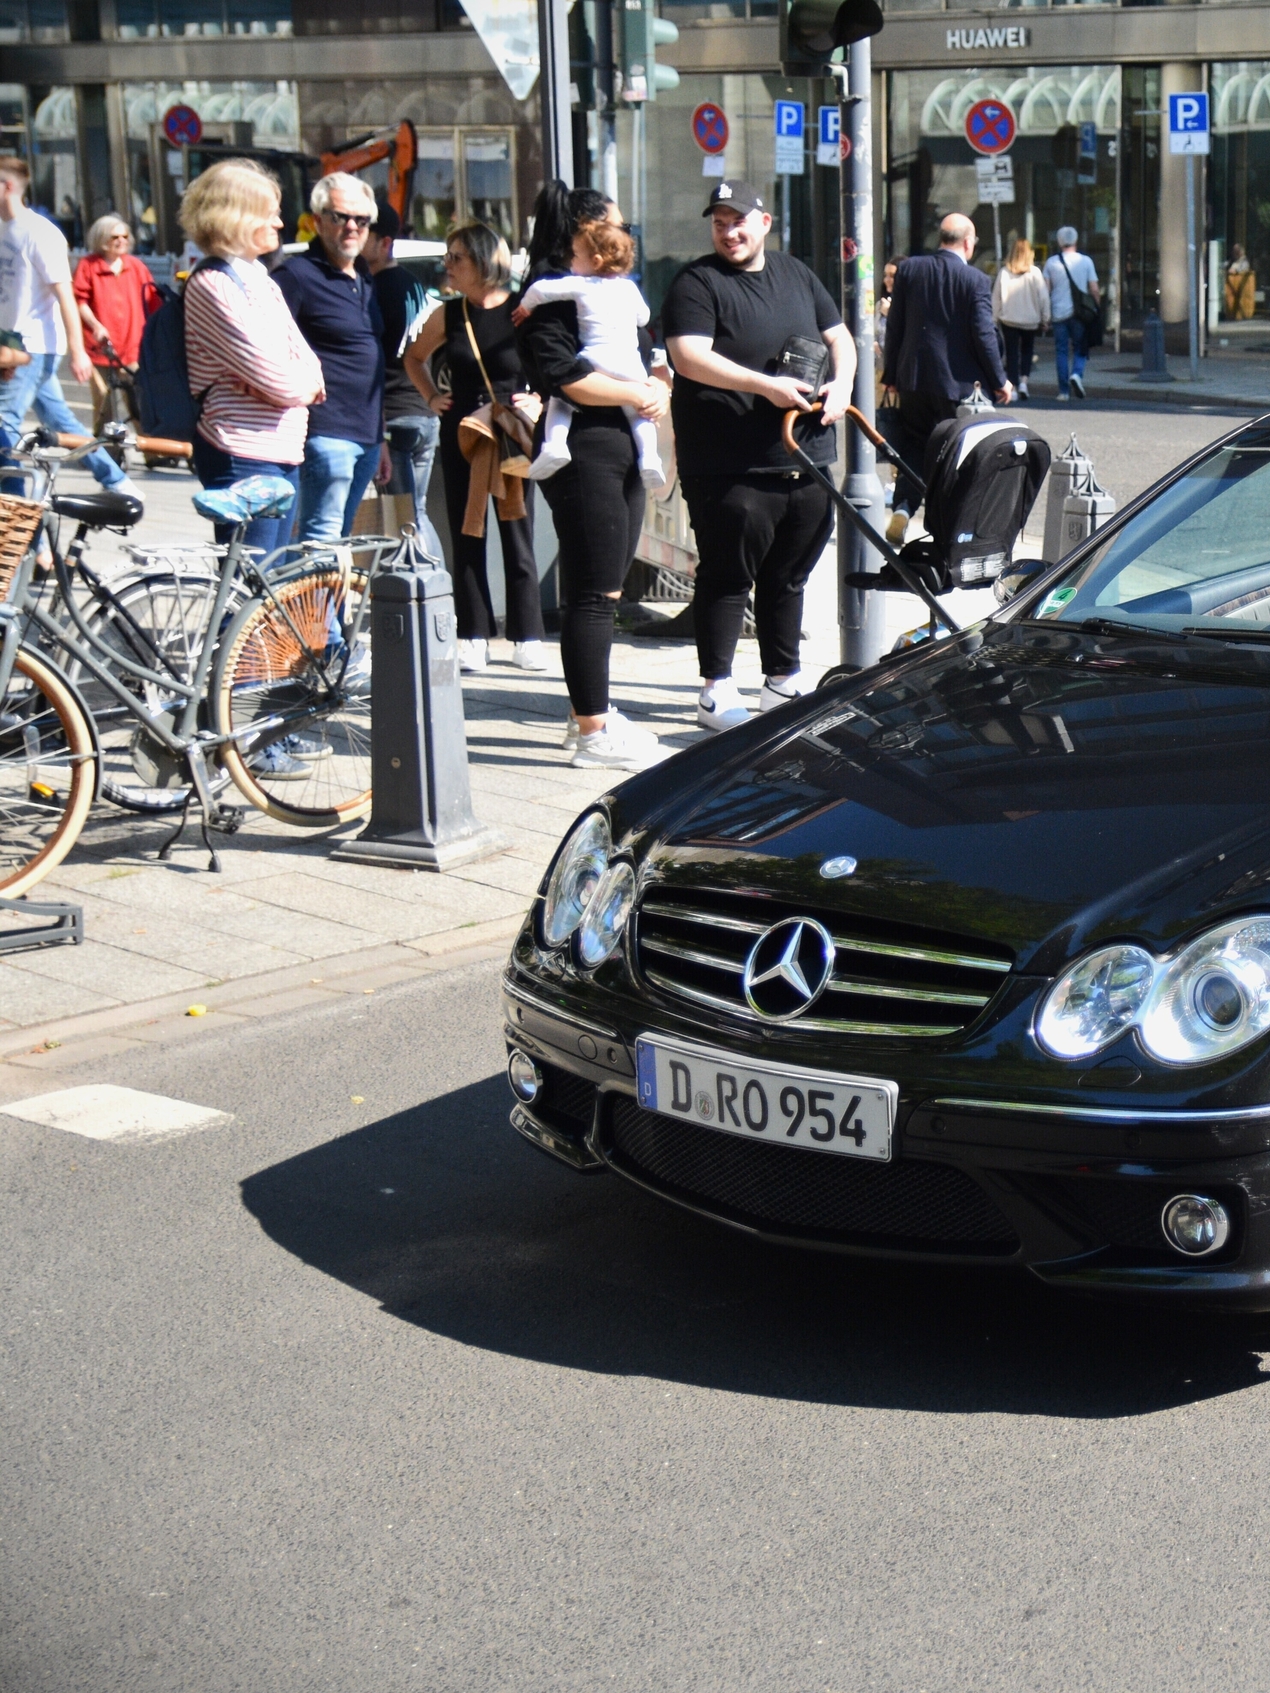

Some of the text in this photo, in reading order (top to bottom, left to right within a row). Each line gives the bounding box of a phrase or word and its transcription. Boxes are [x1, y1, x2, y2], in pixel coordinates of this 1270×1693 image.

[946, 27, 1025, 50] HUAWEI
[781, 105, 798, 134] P
[1177, 97, 1200, 130] P
[669, 1059, 867, 1148] D RO 954
